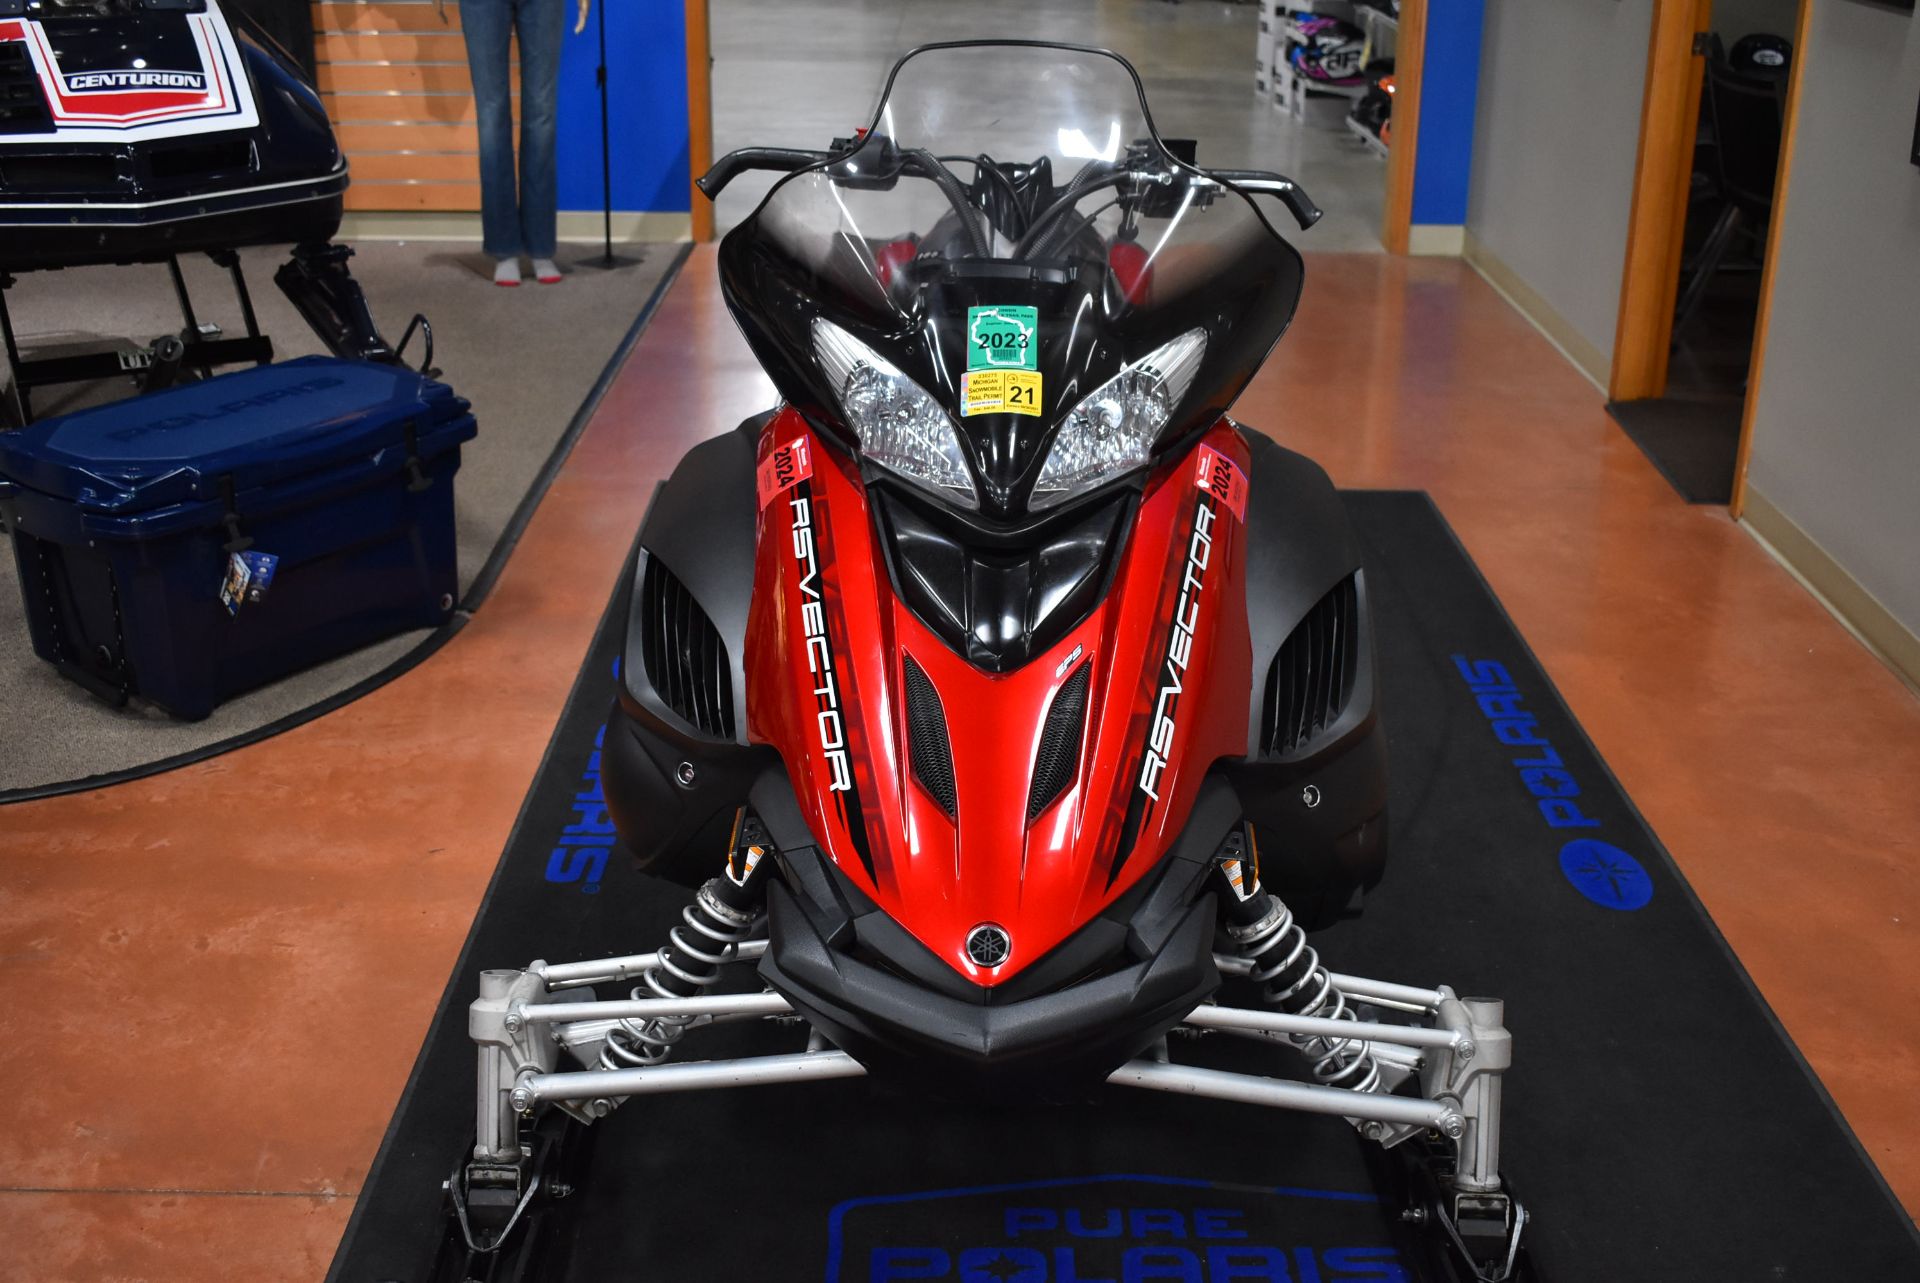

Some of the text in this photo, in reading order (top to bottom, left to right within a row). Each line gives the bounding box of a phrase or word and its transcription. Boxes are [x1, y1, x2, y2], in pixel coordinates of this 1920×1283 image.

[69, 73, 201, 89] CENTURION
[978, 332, 1029, 349] 2023
[1009, 386, 1034, 405] 21
[774, 446, 796, 488] 2024
[1211, 456, 1233, 500] 2024
[1055, 643, 1082, 678] EPS
[1451, 654, 1602, 828] POLARIS
[1005, 1207, 1249, 1238] PURE
[869, 1245, 1409, 1283] POLARIS
